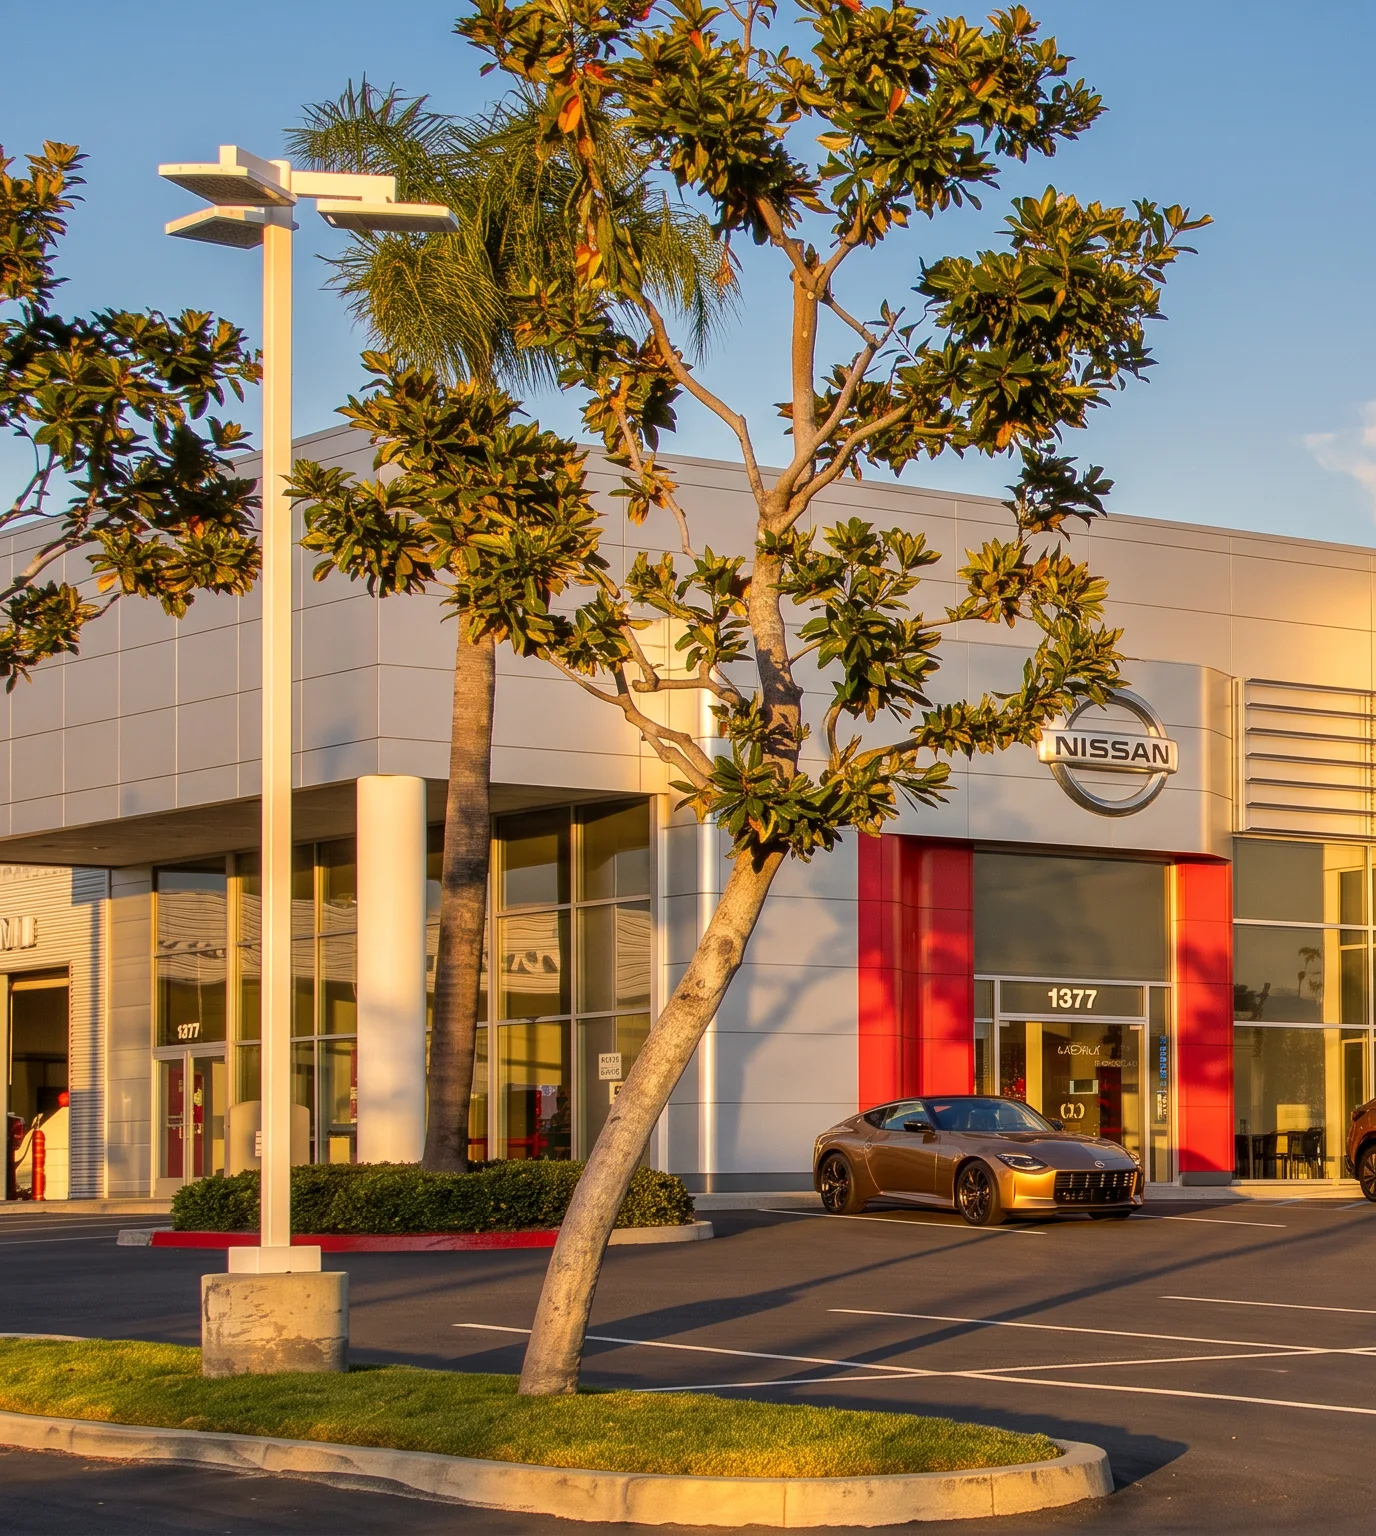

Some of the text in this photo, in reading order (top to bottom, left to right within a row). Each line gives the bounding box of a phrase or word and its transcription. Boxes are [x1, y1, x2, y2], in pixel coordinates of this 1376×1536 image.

[1055, 735, 1169, 765] NISSAN
[1047, 987, 1098, 1009] 1377
[177, 1022, 200, 1039] 1377
